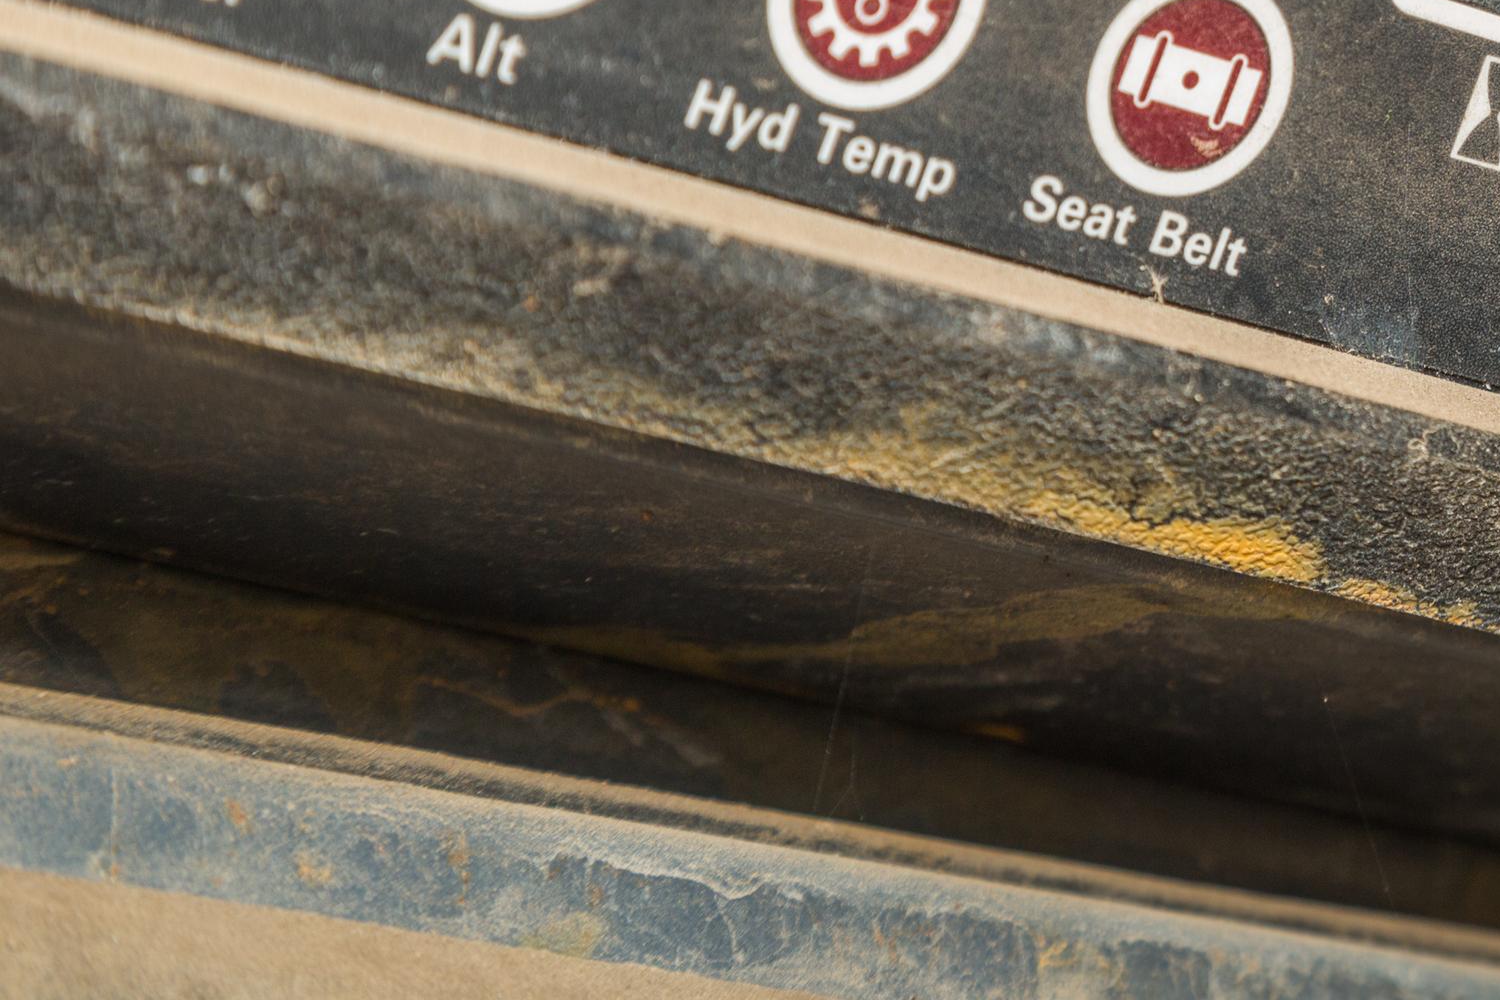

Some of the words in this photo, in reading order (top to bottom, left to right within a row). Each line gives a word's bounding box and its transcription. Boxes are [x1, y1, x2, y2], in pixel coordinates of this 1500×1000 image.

[425, 13, 526, 85] Alt
[683, 78, 801, 151] Hyd
[817, 112, 956, 202] Temp
[1022, 175, 1137, 246] Seat
[1149, 209, 1247, 277] Belt
